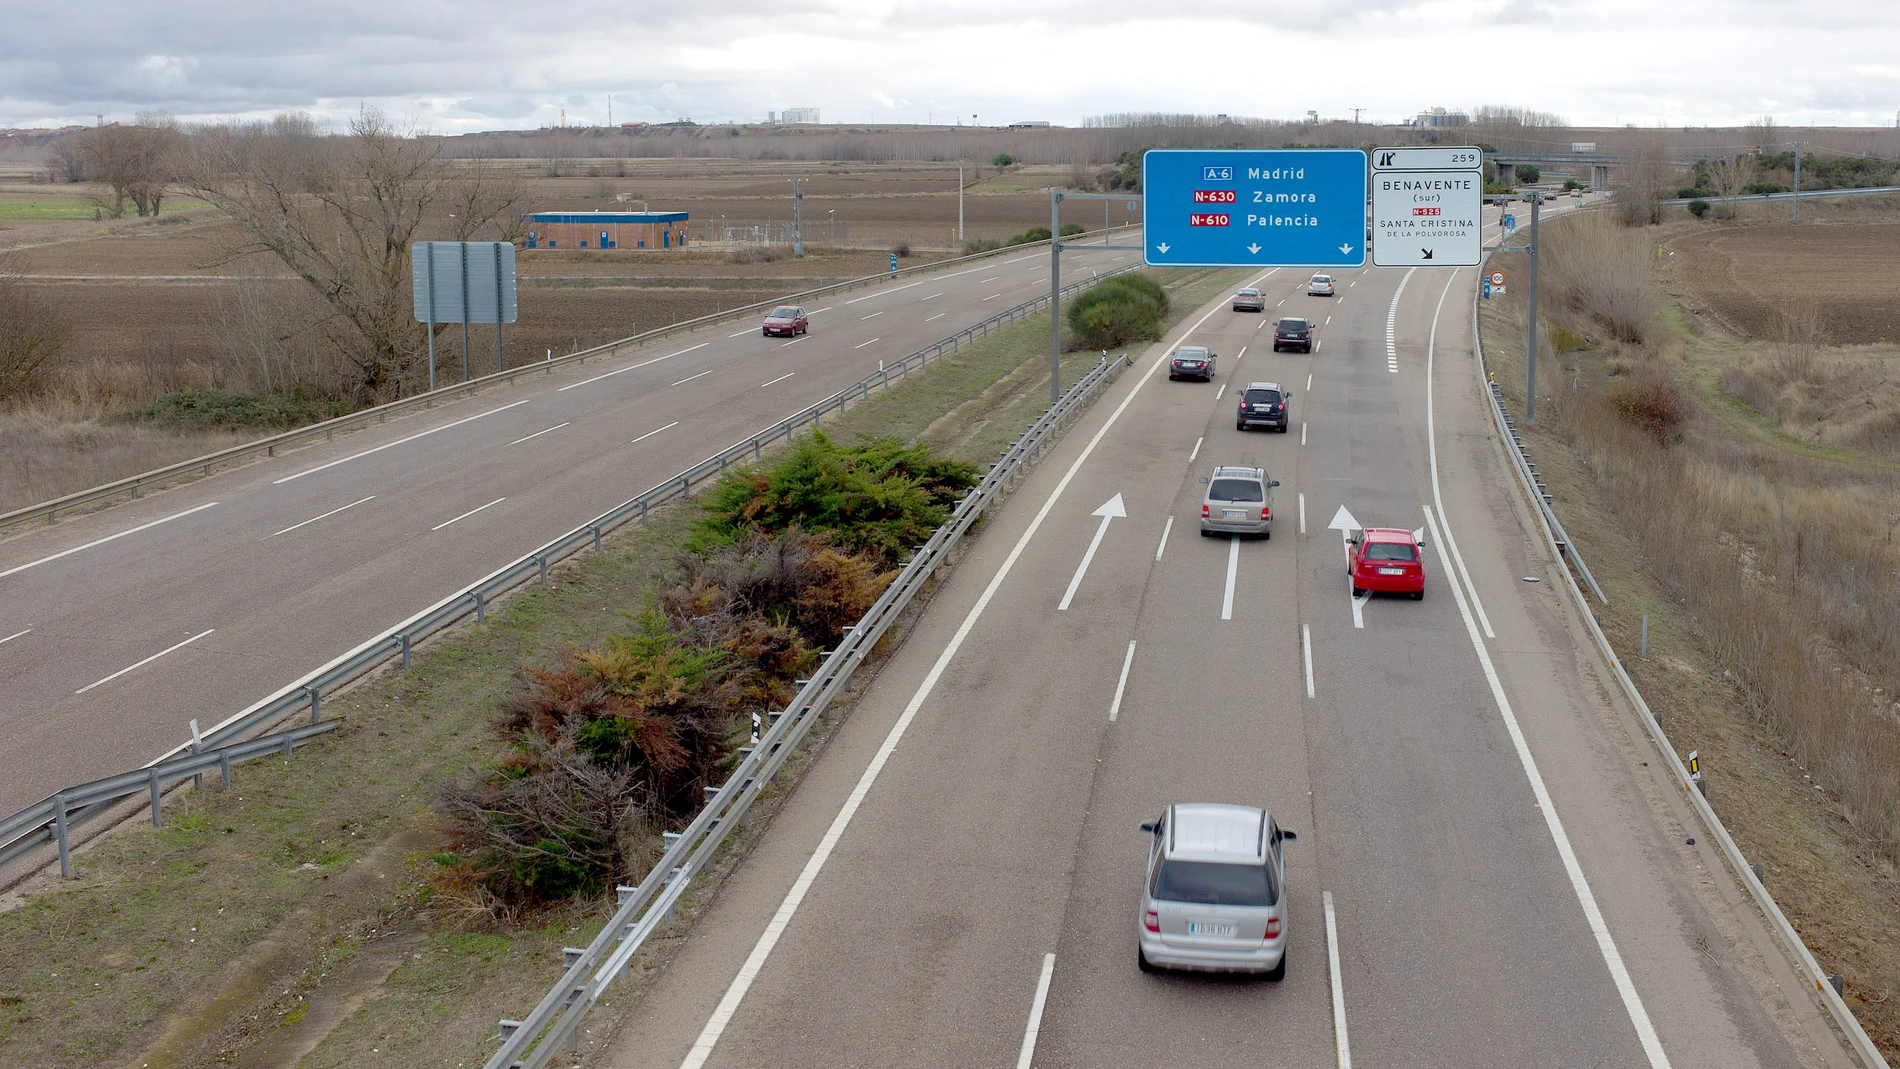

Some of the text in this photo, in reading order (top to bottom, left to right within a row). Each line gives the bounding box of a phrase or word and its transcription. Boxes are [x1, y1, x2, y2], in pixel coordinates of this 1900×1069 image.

[1452, 154, 1475, 163] 259
[1207, 167, 1304, 180] A-6 Madrid
[1383, 180, 1471, 191] BENAVENTE
[1195, 190, 1316, 203] N-630 Zamora
[1412, 193, 1441, 203] (sur)
[1412, 208, 1441, 216] N-525
[1191, 213, 1318, 226] N-610 Palencia
[1380, 220, 1474, 228] SANTA CRISTINA
[1415, 230, 1466, 238] POLVOROSA
